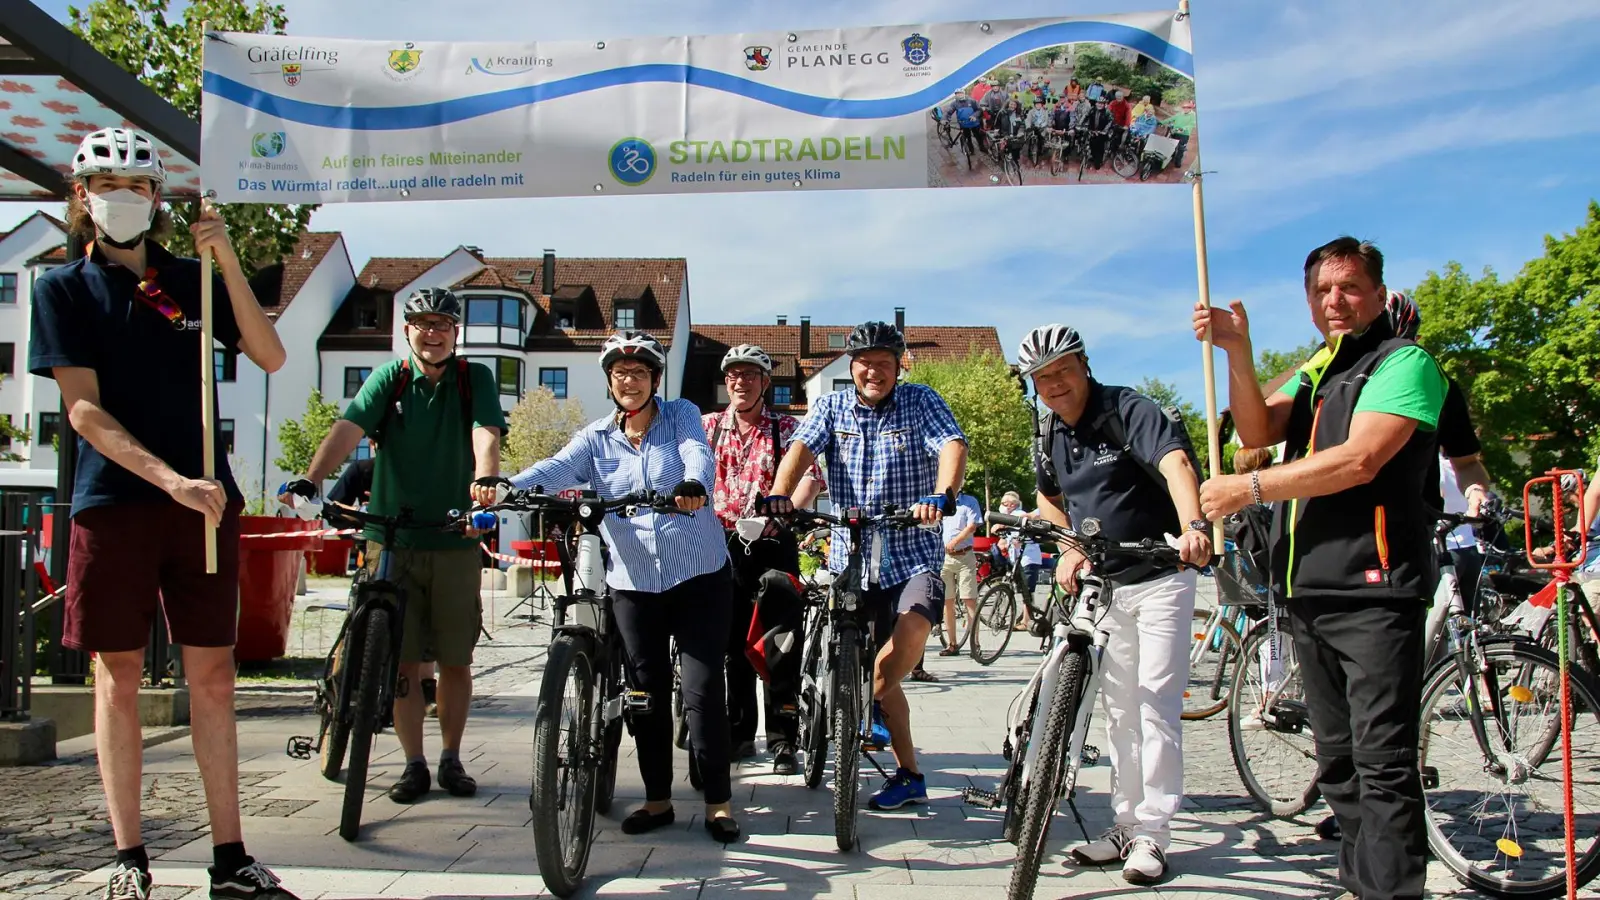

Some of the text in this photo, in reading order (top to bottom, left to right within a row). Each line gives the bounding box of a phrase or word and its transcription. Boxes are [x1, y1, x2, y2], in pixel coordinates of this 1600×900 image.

[248, 45, 338, 65] Gräfelfing
[787, 43, 848, 53] GEMEINDE
[497, 56, 553, 67] Krailling
[787, 52, 889, 68] PLANEGG
[322, 149, 522, 169] Auf ein faires Miteinander
[668, 134, 906, 165] STADTRADELN
[238, 178, 267, 191] Das
[271, 178, 332, 192] Würmtal
[421, 175, 447, 188] alle
[451, 173, 496, 187] radeln
[501, 172, 524, 185] mit
[671, 168, 841, 183] Radeln für ein gutes Klima
[1270, 627, 1279, 661] Neuried
